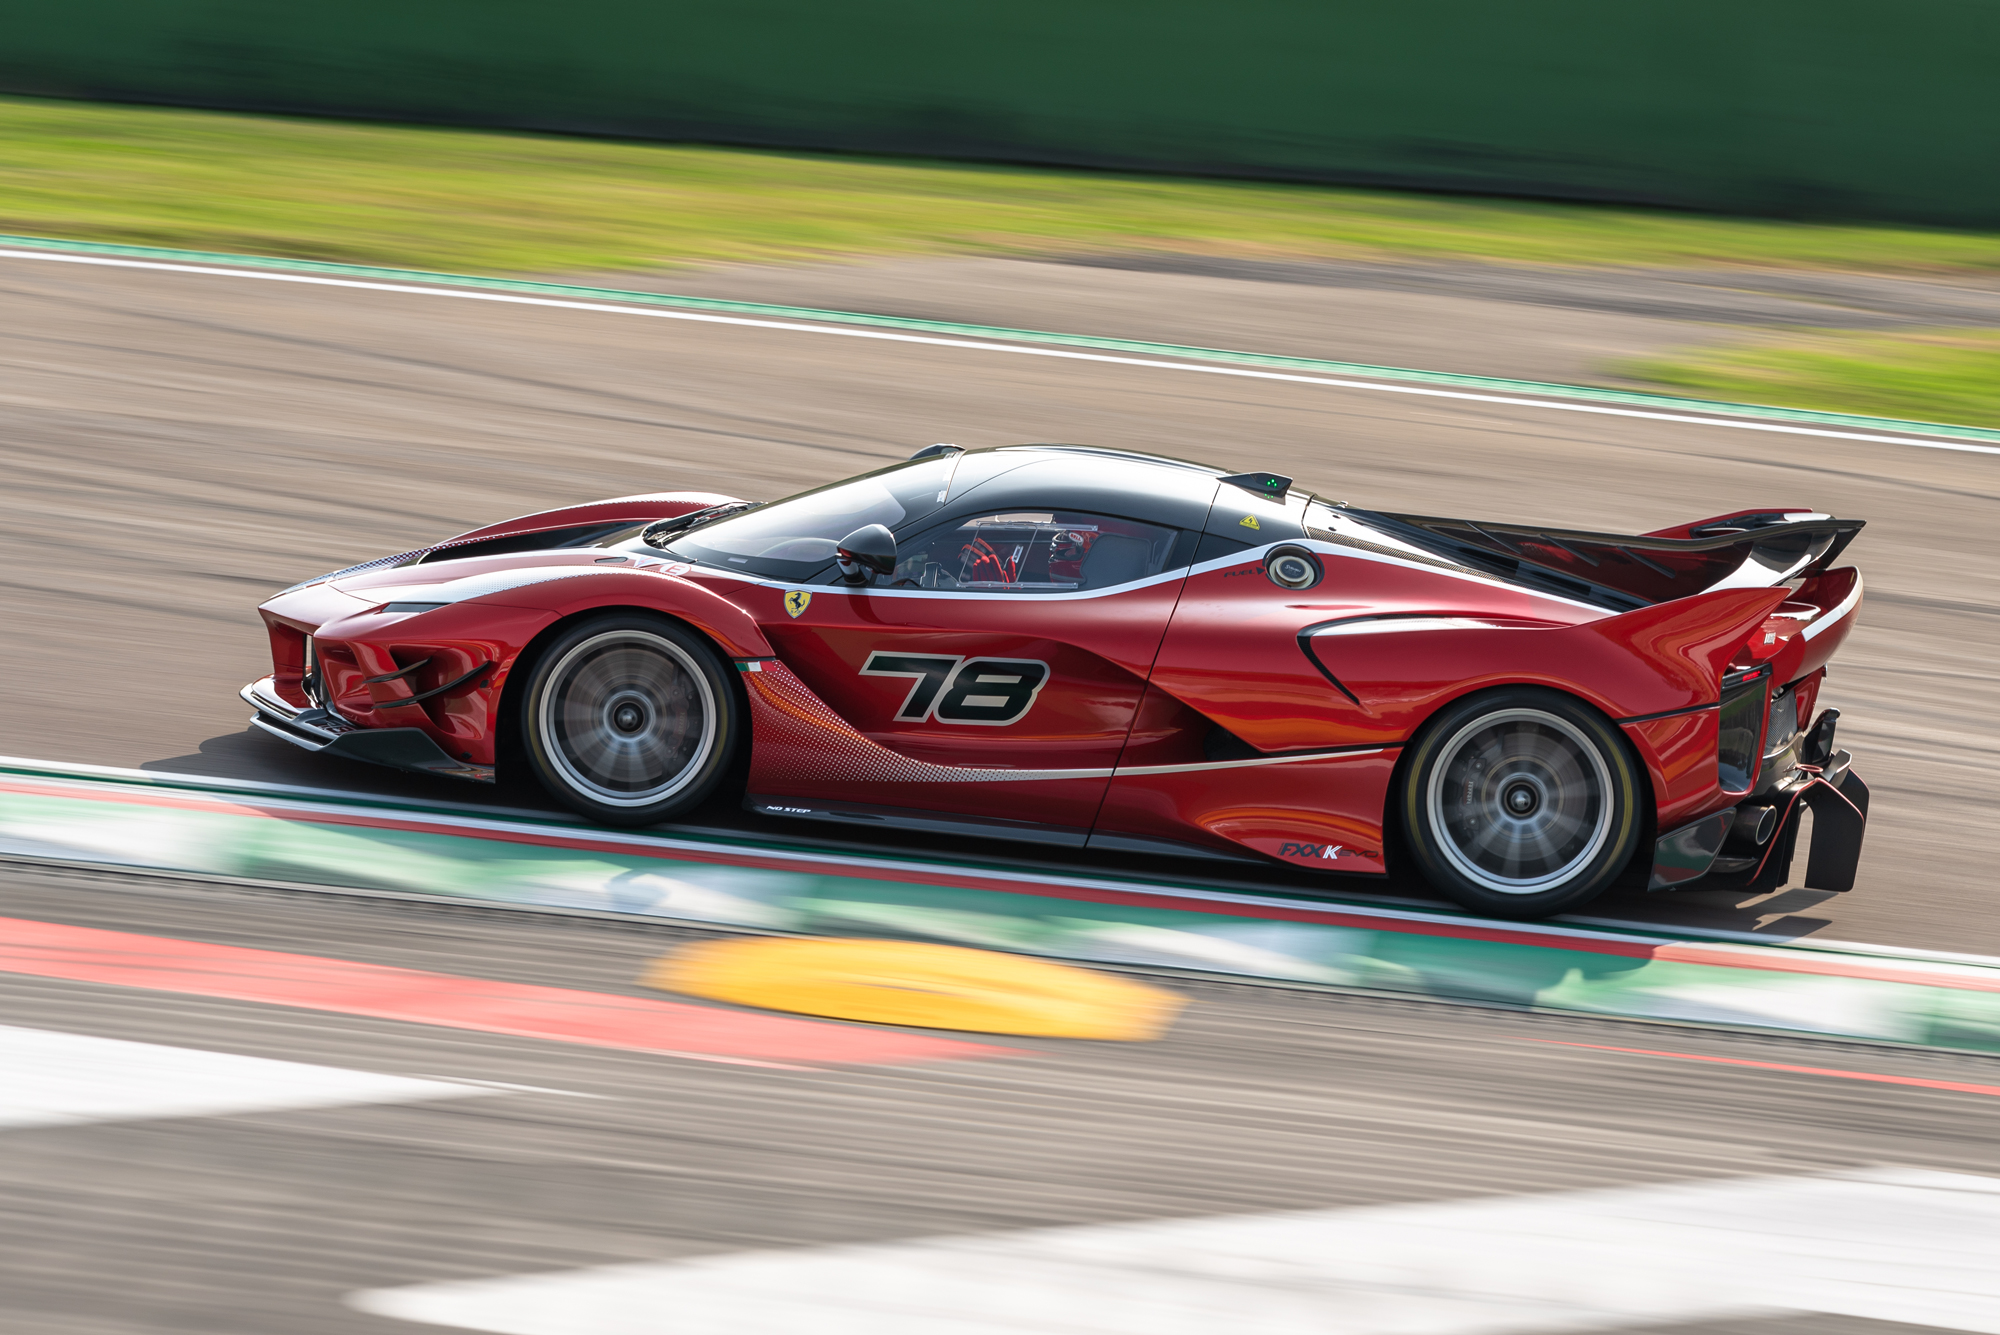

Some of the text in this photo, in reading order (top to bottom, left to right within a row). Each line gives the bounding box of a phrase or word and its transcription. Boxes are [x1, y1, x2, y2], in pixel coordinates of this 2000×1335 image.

[665, 564, 685, 574] E
[1223, 570, 1256, 578] FUEL
[858, 650, 1051, 726] 78
